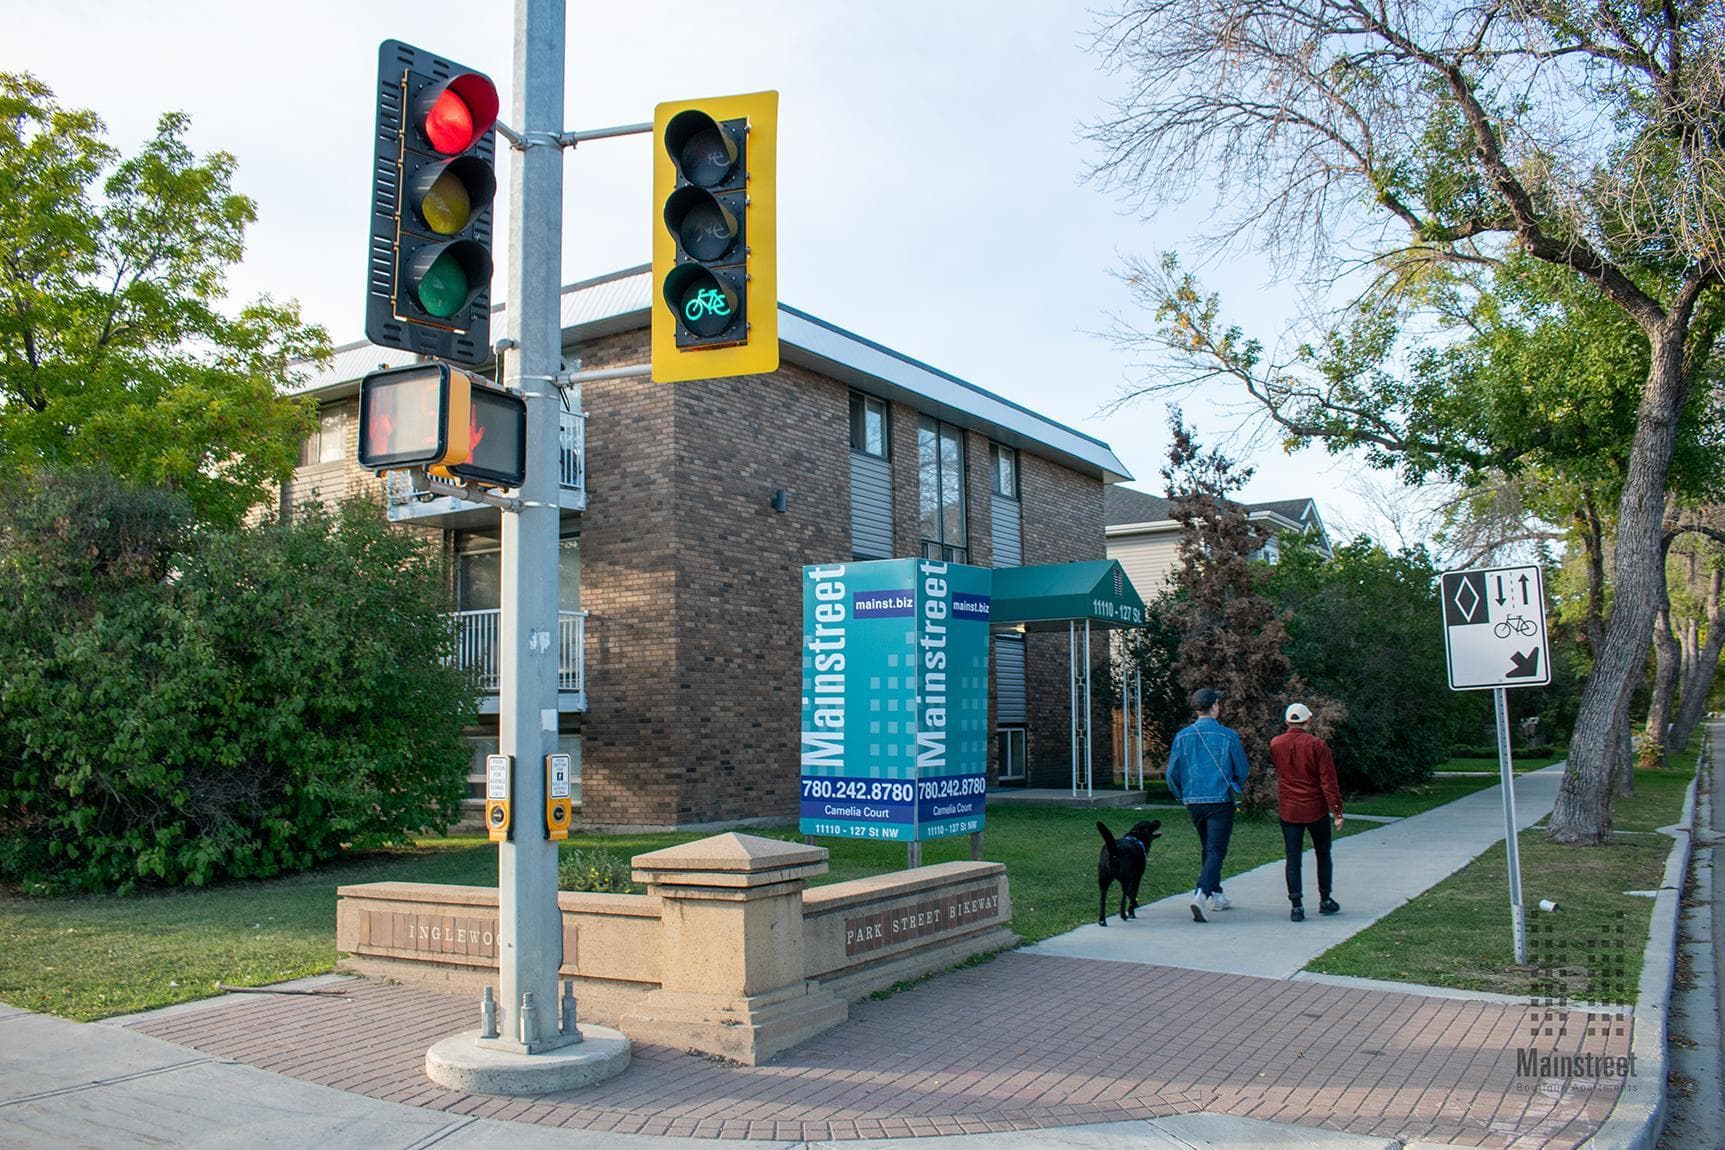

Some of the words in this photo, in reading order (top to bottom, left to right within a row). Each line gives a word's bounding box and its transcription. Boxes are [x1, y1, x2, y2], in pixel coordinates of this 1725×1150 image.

[855, 597, 913, 611] mainst.biz
[953, 601, 990, 613] mainst.biz
[1093, 599, 1114, 617] 11110
[1119, 604, 1131, 620] 127
[801, 565, 846, 767] Mainstreet
[917, 561, 948, 767] Mainstreet
[802, 780, 913, 801] 780.242.8780
[918, 777, 986, 800] 780.242.8780
[824, 804, 861, 817] Camelia
[863, 806, 889, 818] Court
[933, 804, 956, 816] Camelia
[957, 802, 972, 813] Court
[815, 824, 840, 834] 11110
[849, 826, 866, 836] 127
[868, 826, 879, 837] St
[882, 828, 899, 838] NW
[927, 824, 944, 836] 11110
[949, 823, 959, 833] 127
[960, 821, 967, 831] St
[967, 820, 978, 830] NW
[847, 924, 882, 945] PARK
[892, 909, 941, 933] STREET
[949, 894, 999, 919] BIKEWAY
